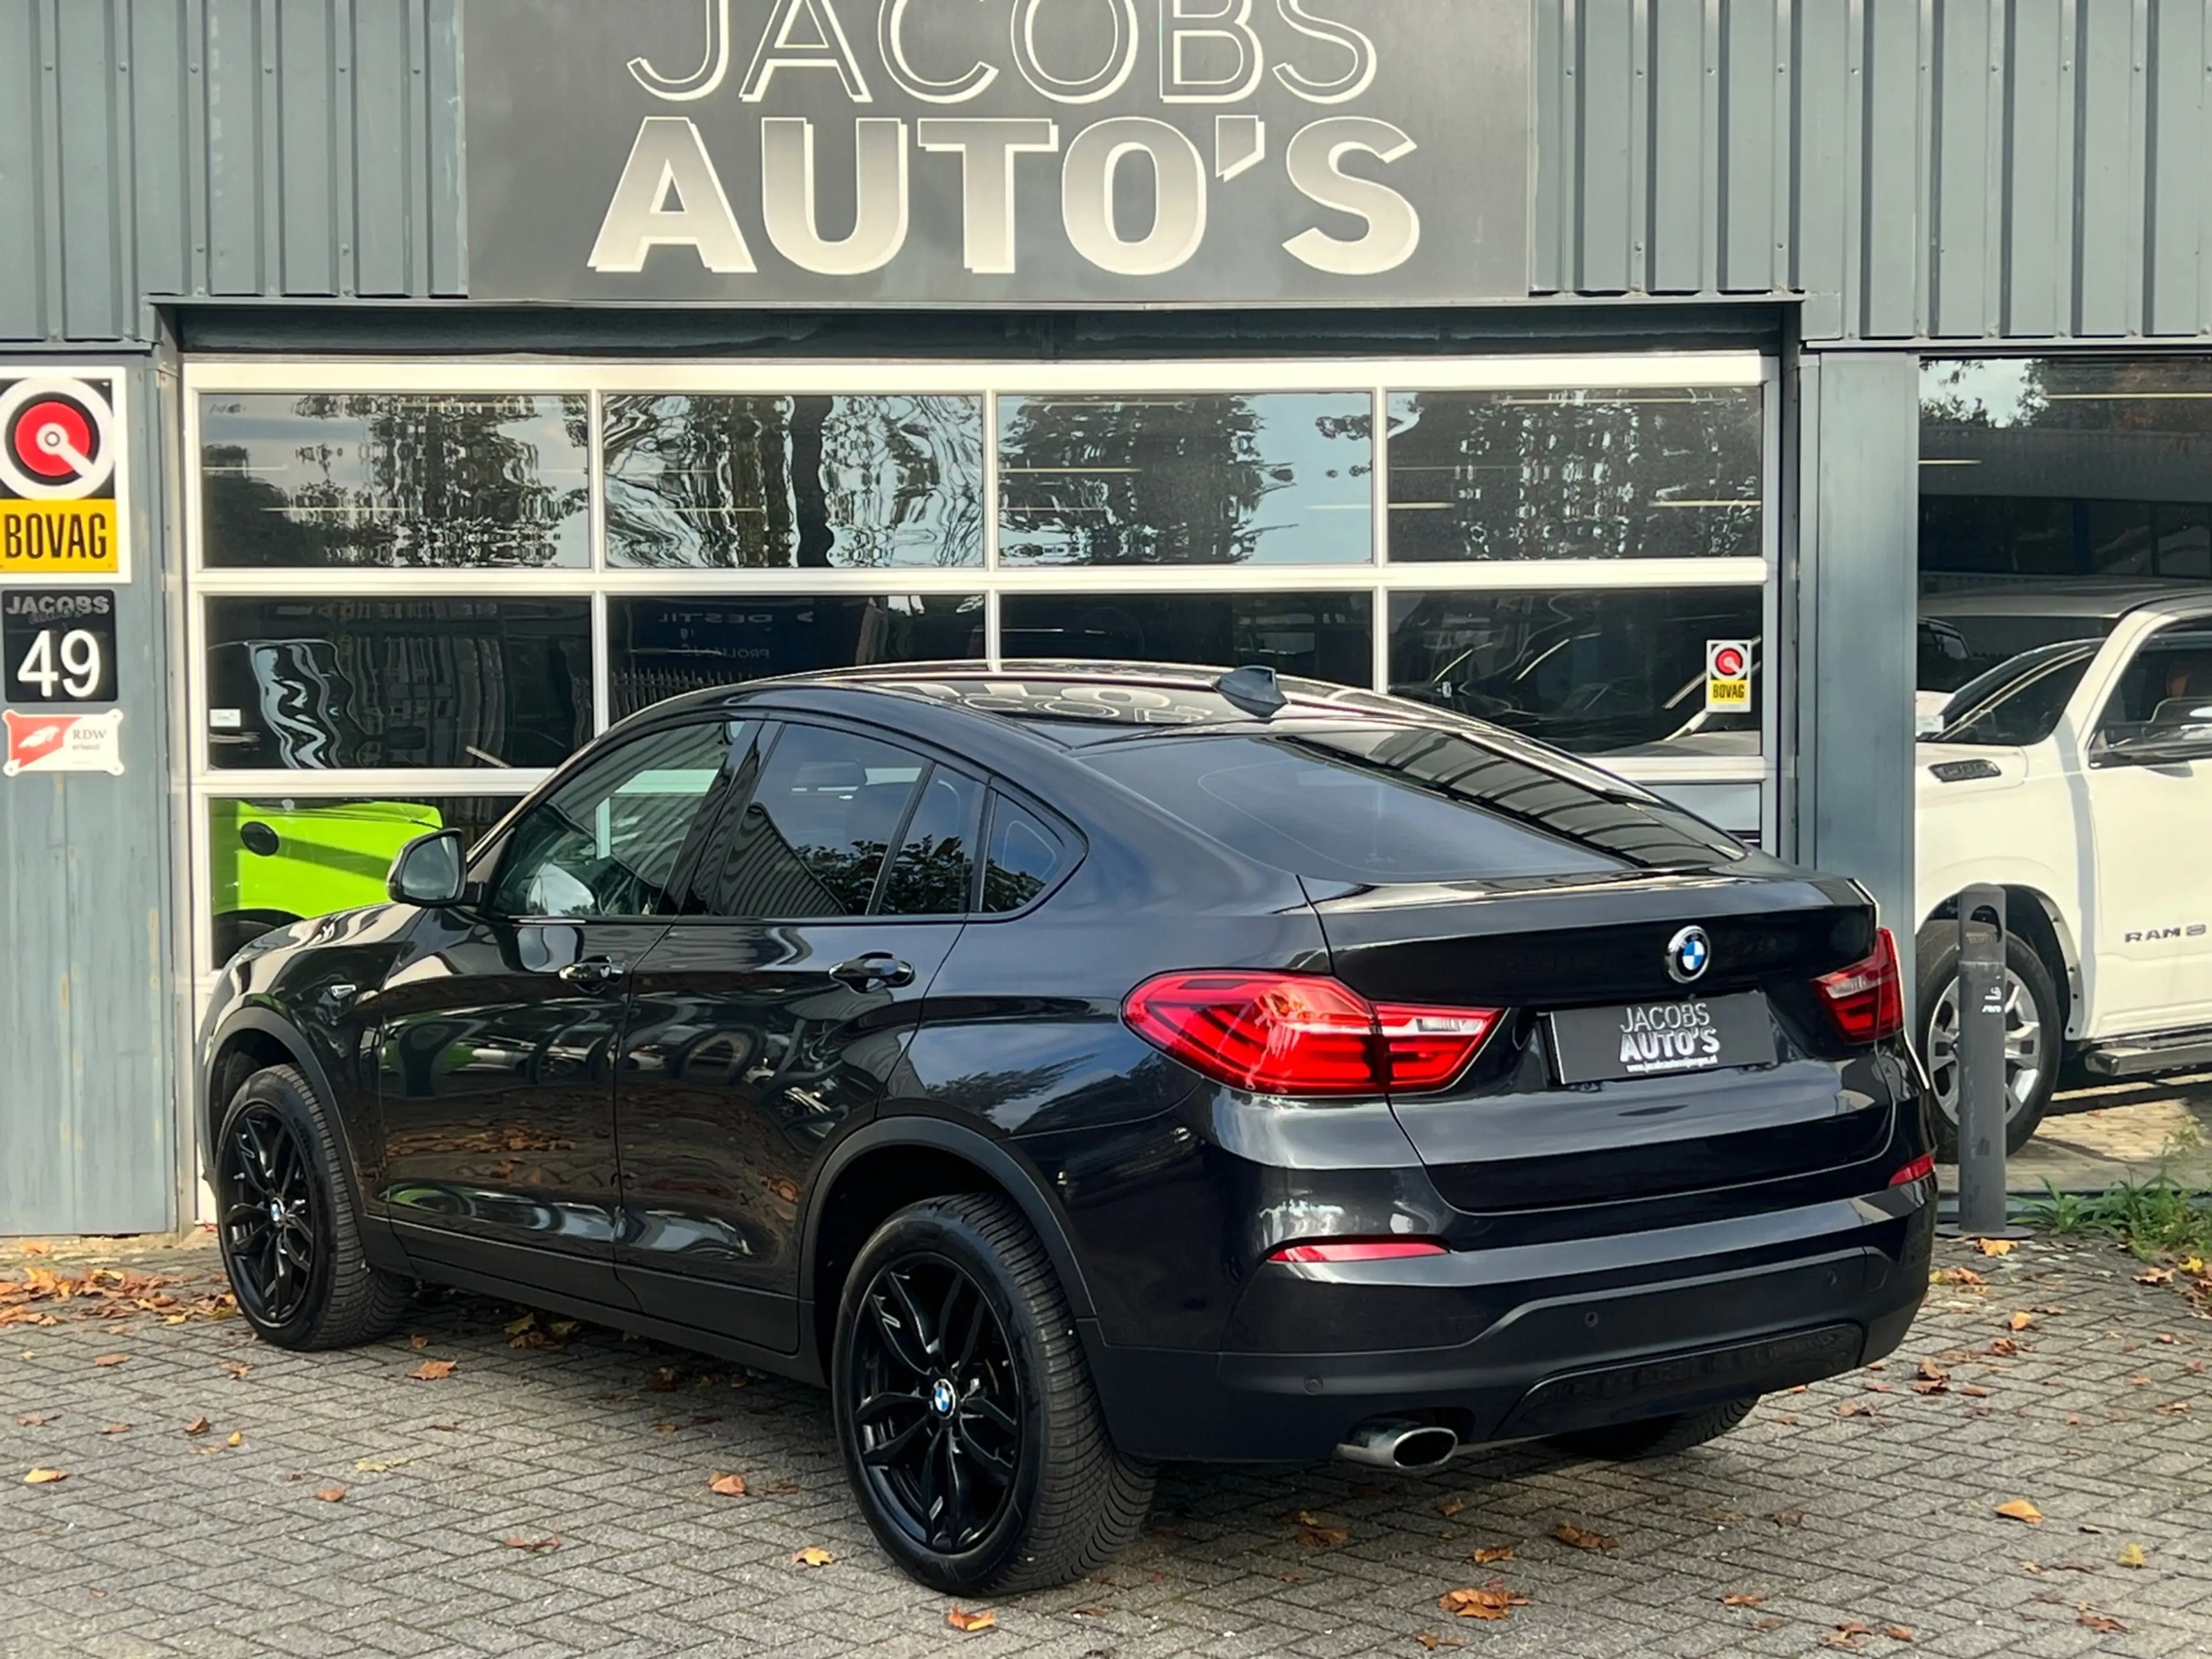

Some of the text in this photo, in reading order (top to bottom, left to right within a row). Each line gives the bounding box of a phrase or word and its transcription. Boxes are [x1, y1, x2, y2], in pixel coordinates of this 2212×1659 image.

[627, 0, 1377, 103] JACOBS
[586, 116, 1421, 275] AUTO'S
[4, 512, 108, 559] BOVAG
[6, 596, 109, 615] JACOBS
[17, 630, 100, 698] 49
[1713, 684, 1745, 698] BOVAG
[73, 729, 107, 740] RDW
[2124, 927, 2181, 942] RAM
[1620, 1002, 1710, 1033] JACOBS
[1619, 1027, 1721, 1063] AUTO'S
